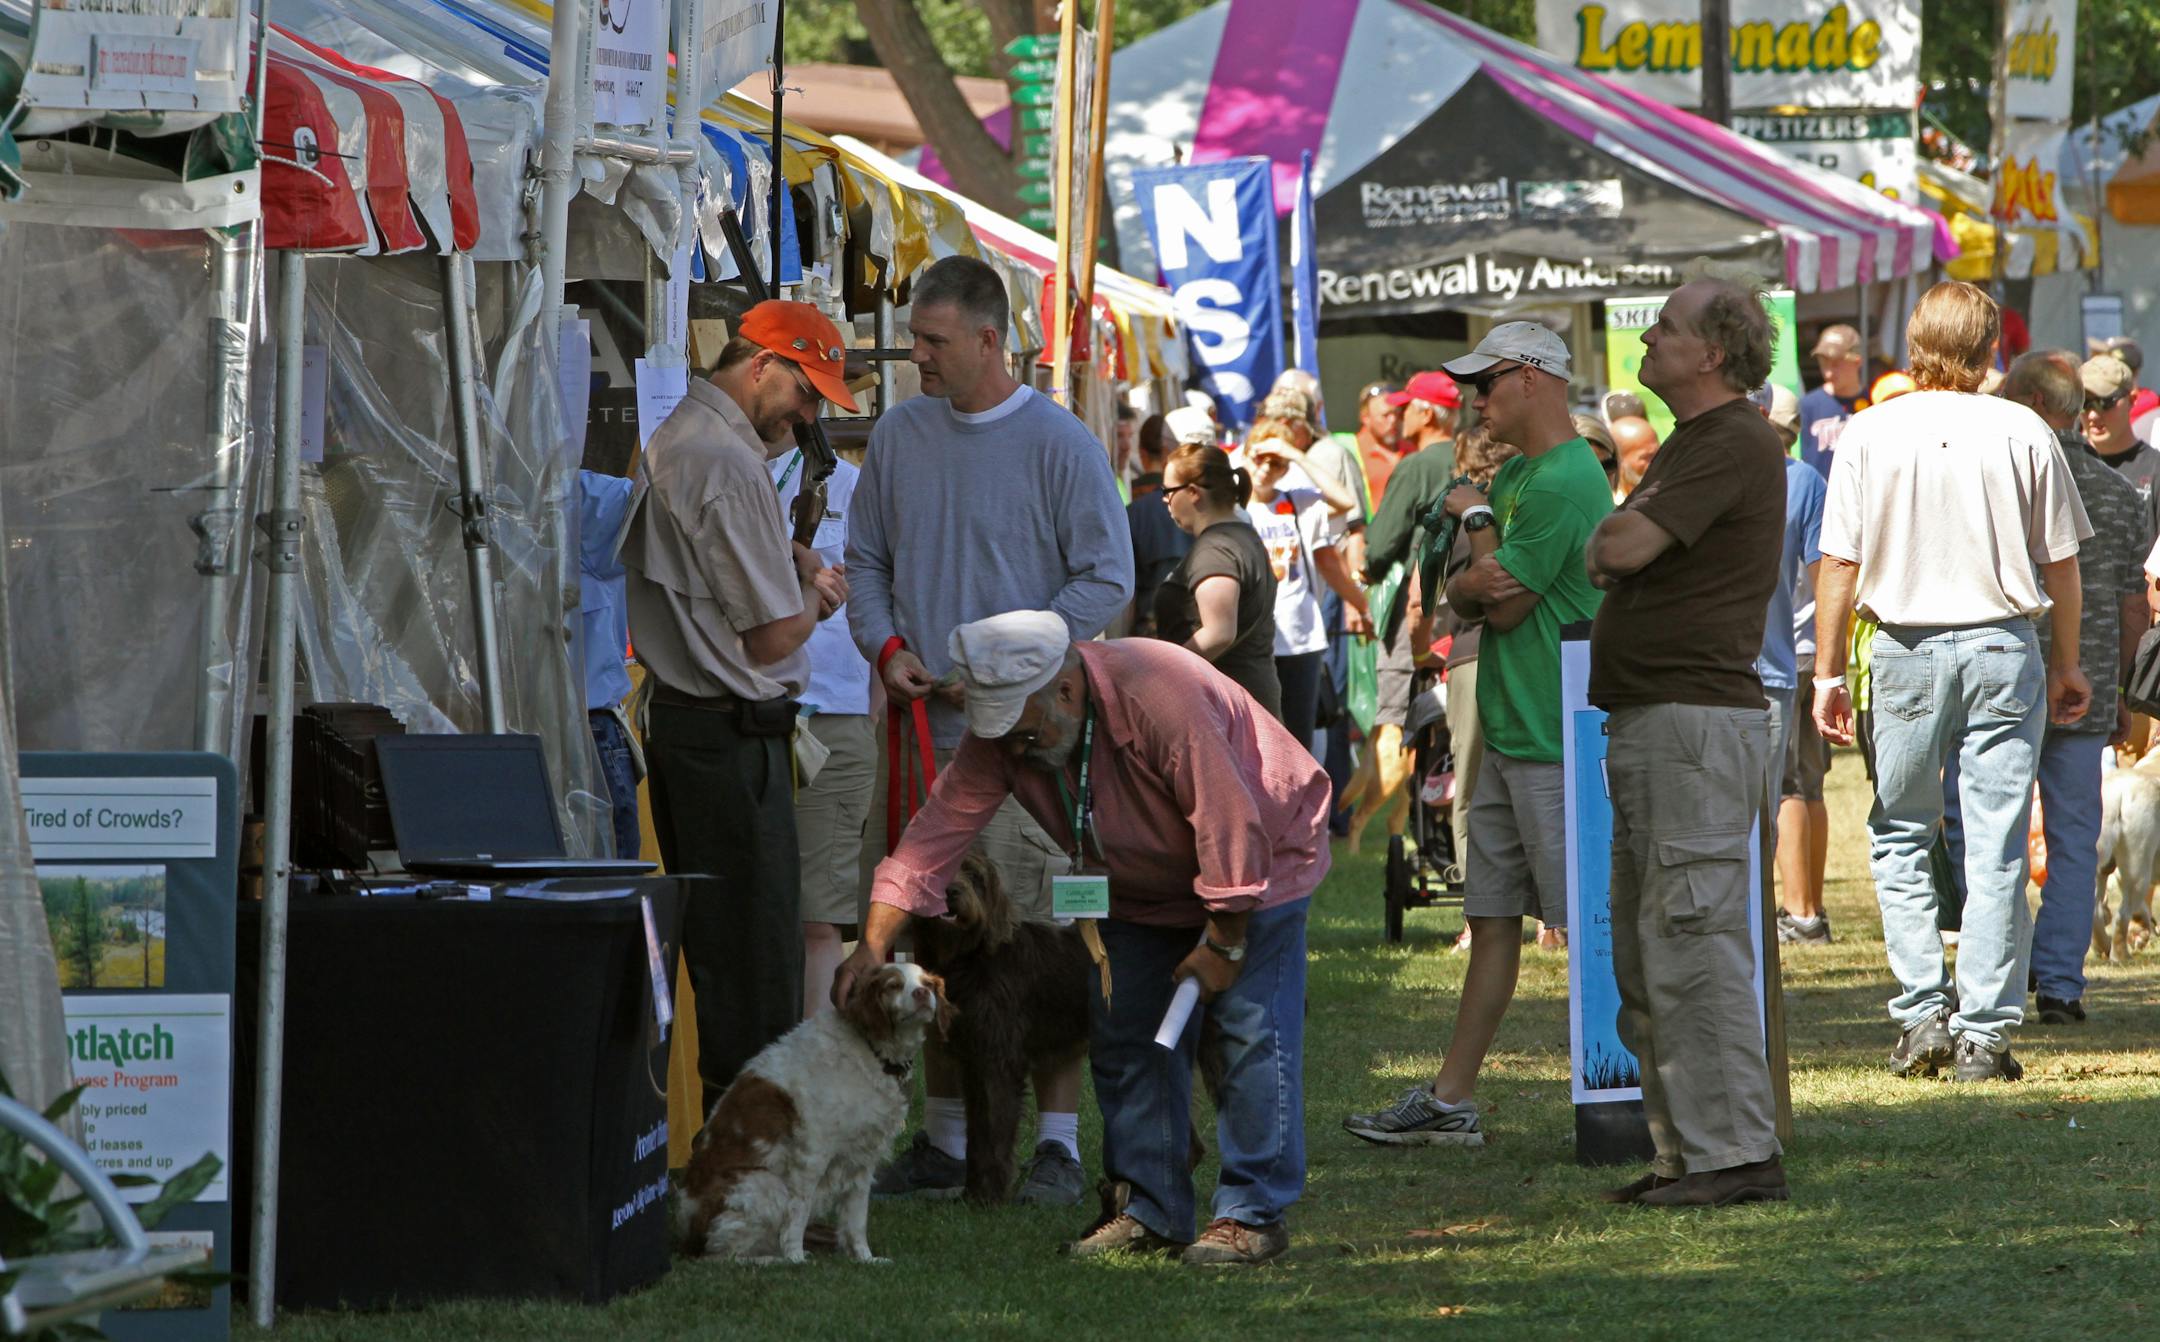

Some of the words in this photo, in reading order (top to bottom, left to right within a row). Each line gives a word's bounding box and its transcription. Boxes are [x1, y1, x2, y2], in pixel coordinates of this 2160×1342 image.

[1577, 4, 1882, 71] Lemnade
[1732, 115, 1869, 139] PPETIZERS
[1361, 176, 1508, 206] Renewal
[1317, 254, 1479, 305] Renewal
[1486, 259, 1525, 300] by
[1528, 257, 1673, 290] Andersen
[73, 808, 92, 828] of
[98, 808, 183, 828] Crowds?
[113, 1070, 178, 1092] Program
[105, 1103, 147, 1117] priced
[100, 1139, 143, 1151] leases
[96, 1157, 123, 1168] cres
[127, 1155, 153, 1168] and
[156, 1158, 174, 1170] up
